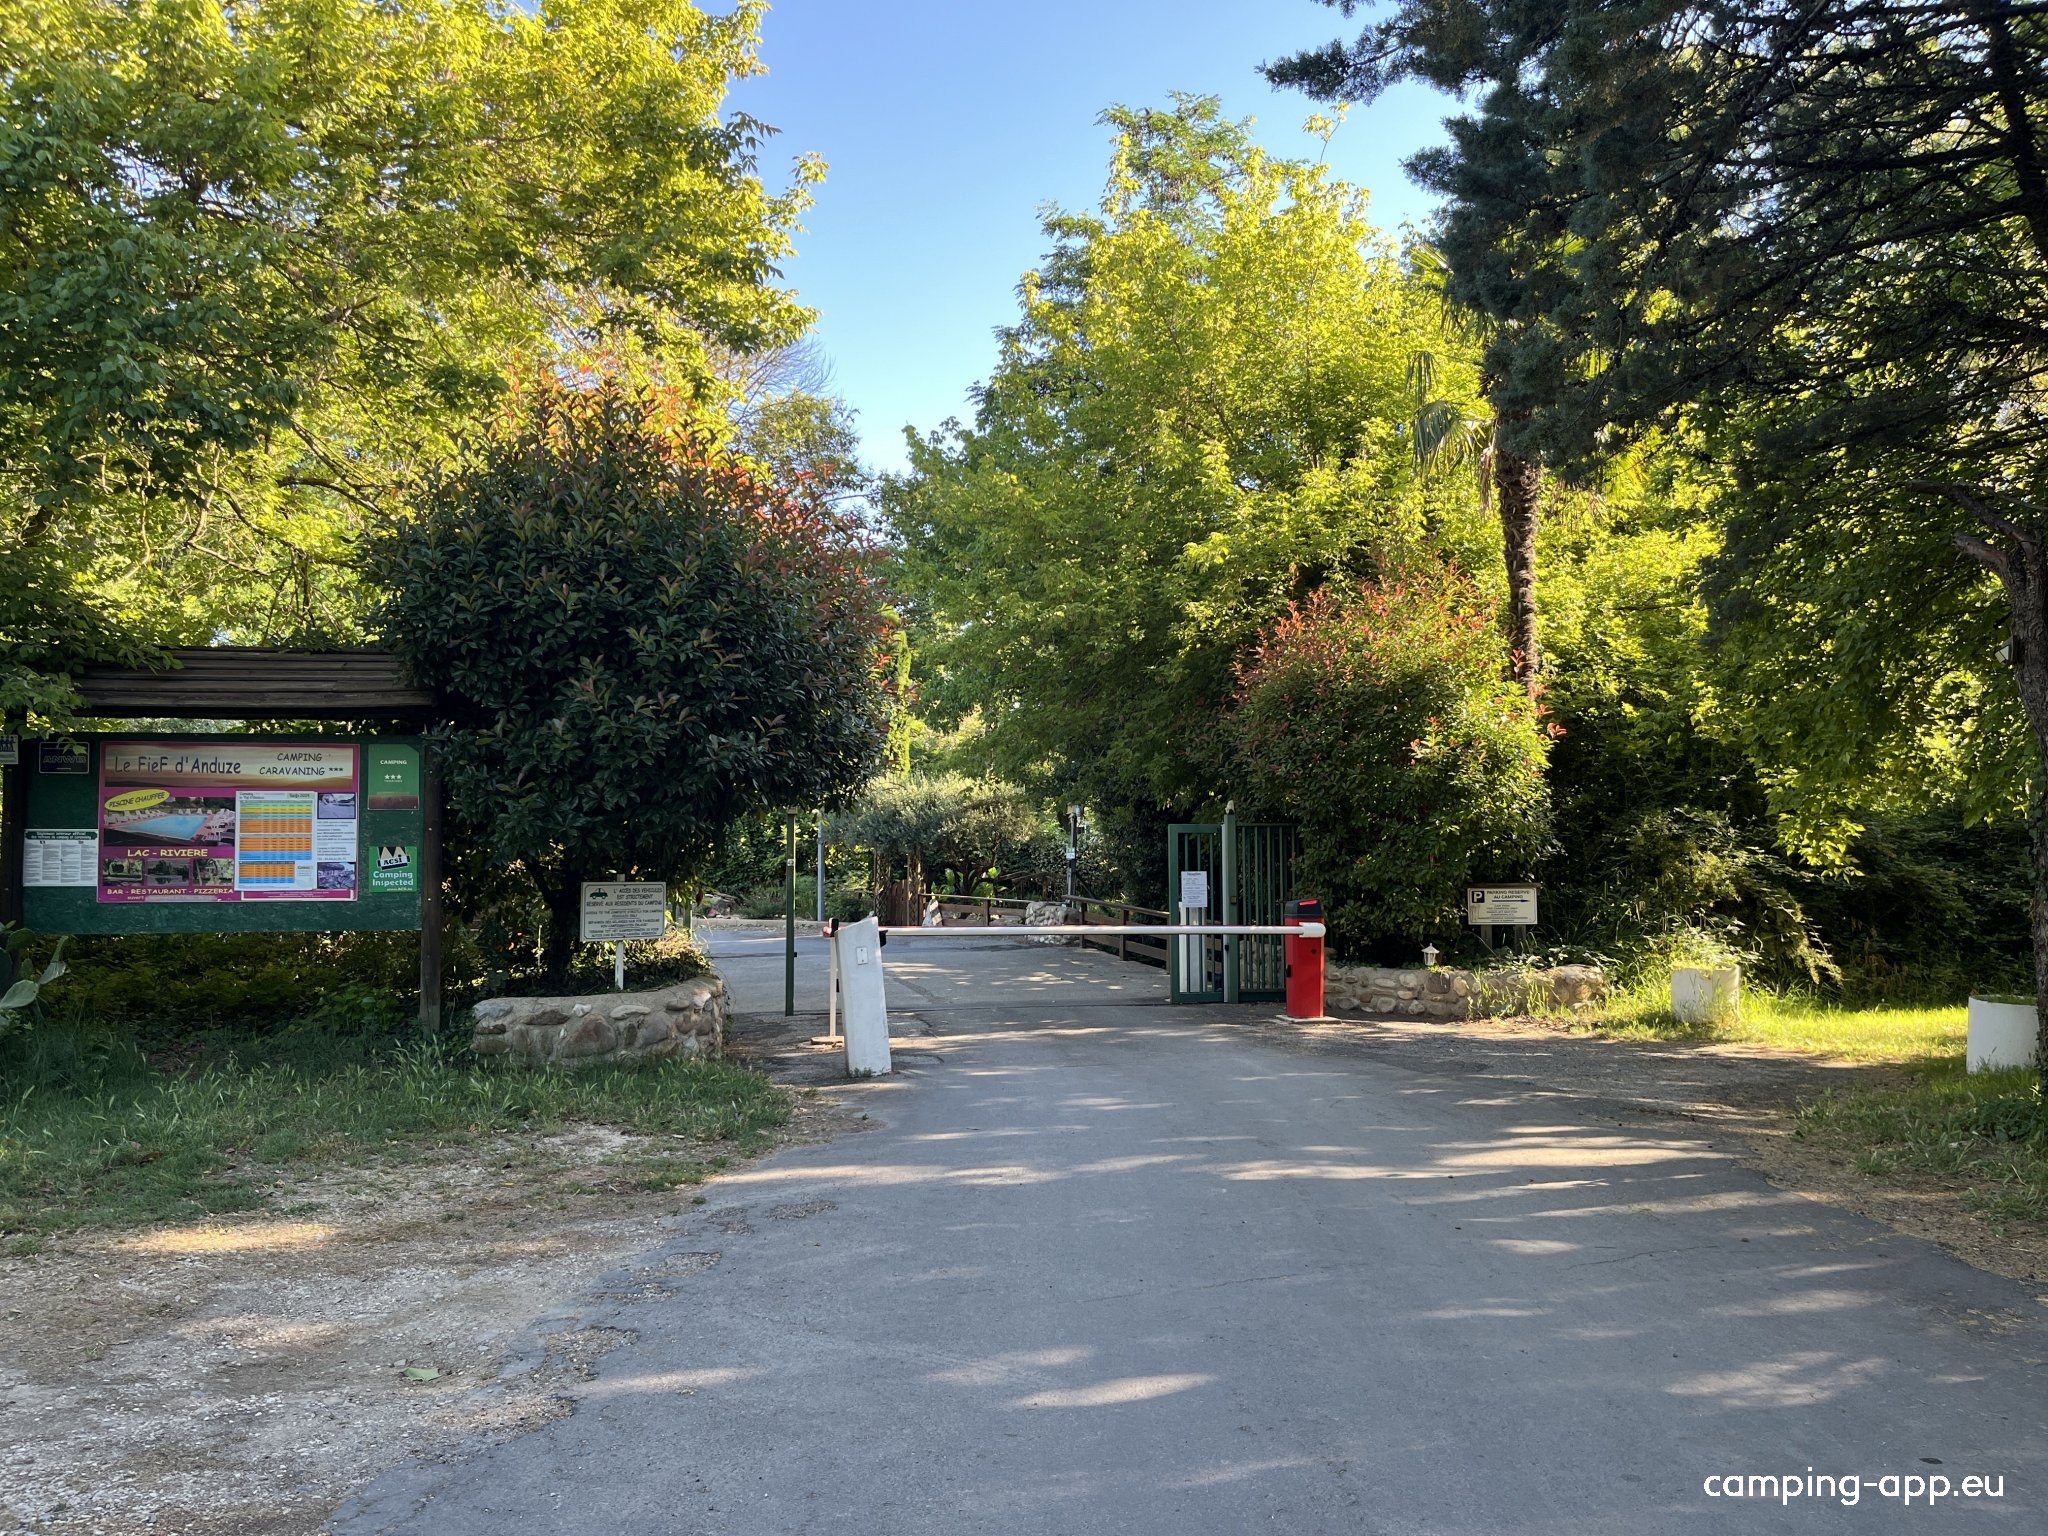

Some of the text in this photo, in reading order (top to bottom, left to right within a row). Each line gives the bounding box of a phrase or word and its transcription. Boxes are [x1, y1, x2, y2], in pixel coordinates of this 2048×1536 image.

[276, 752, 323, 762] CAMPING
[114, 756, 241, 774] Le FieF d'Anduze
[259, 766, 325, 776] CARAVANING
[108, 797, 134, 808] PISCINE
[127, 849, 150, 857] LAC
[160, 849, 208, 857] RIVIERE
[373, 870, 413, 879] Camping
[372, 879, 414, 888] Inspected
[1473, 891, 1483, 902] P
